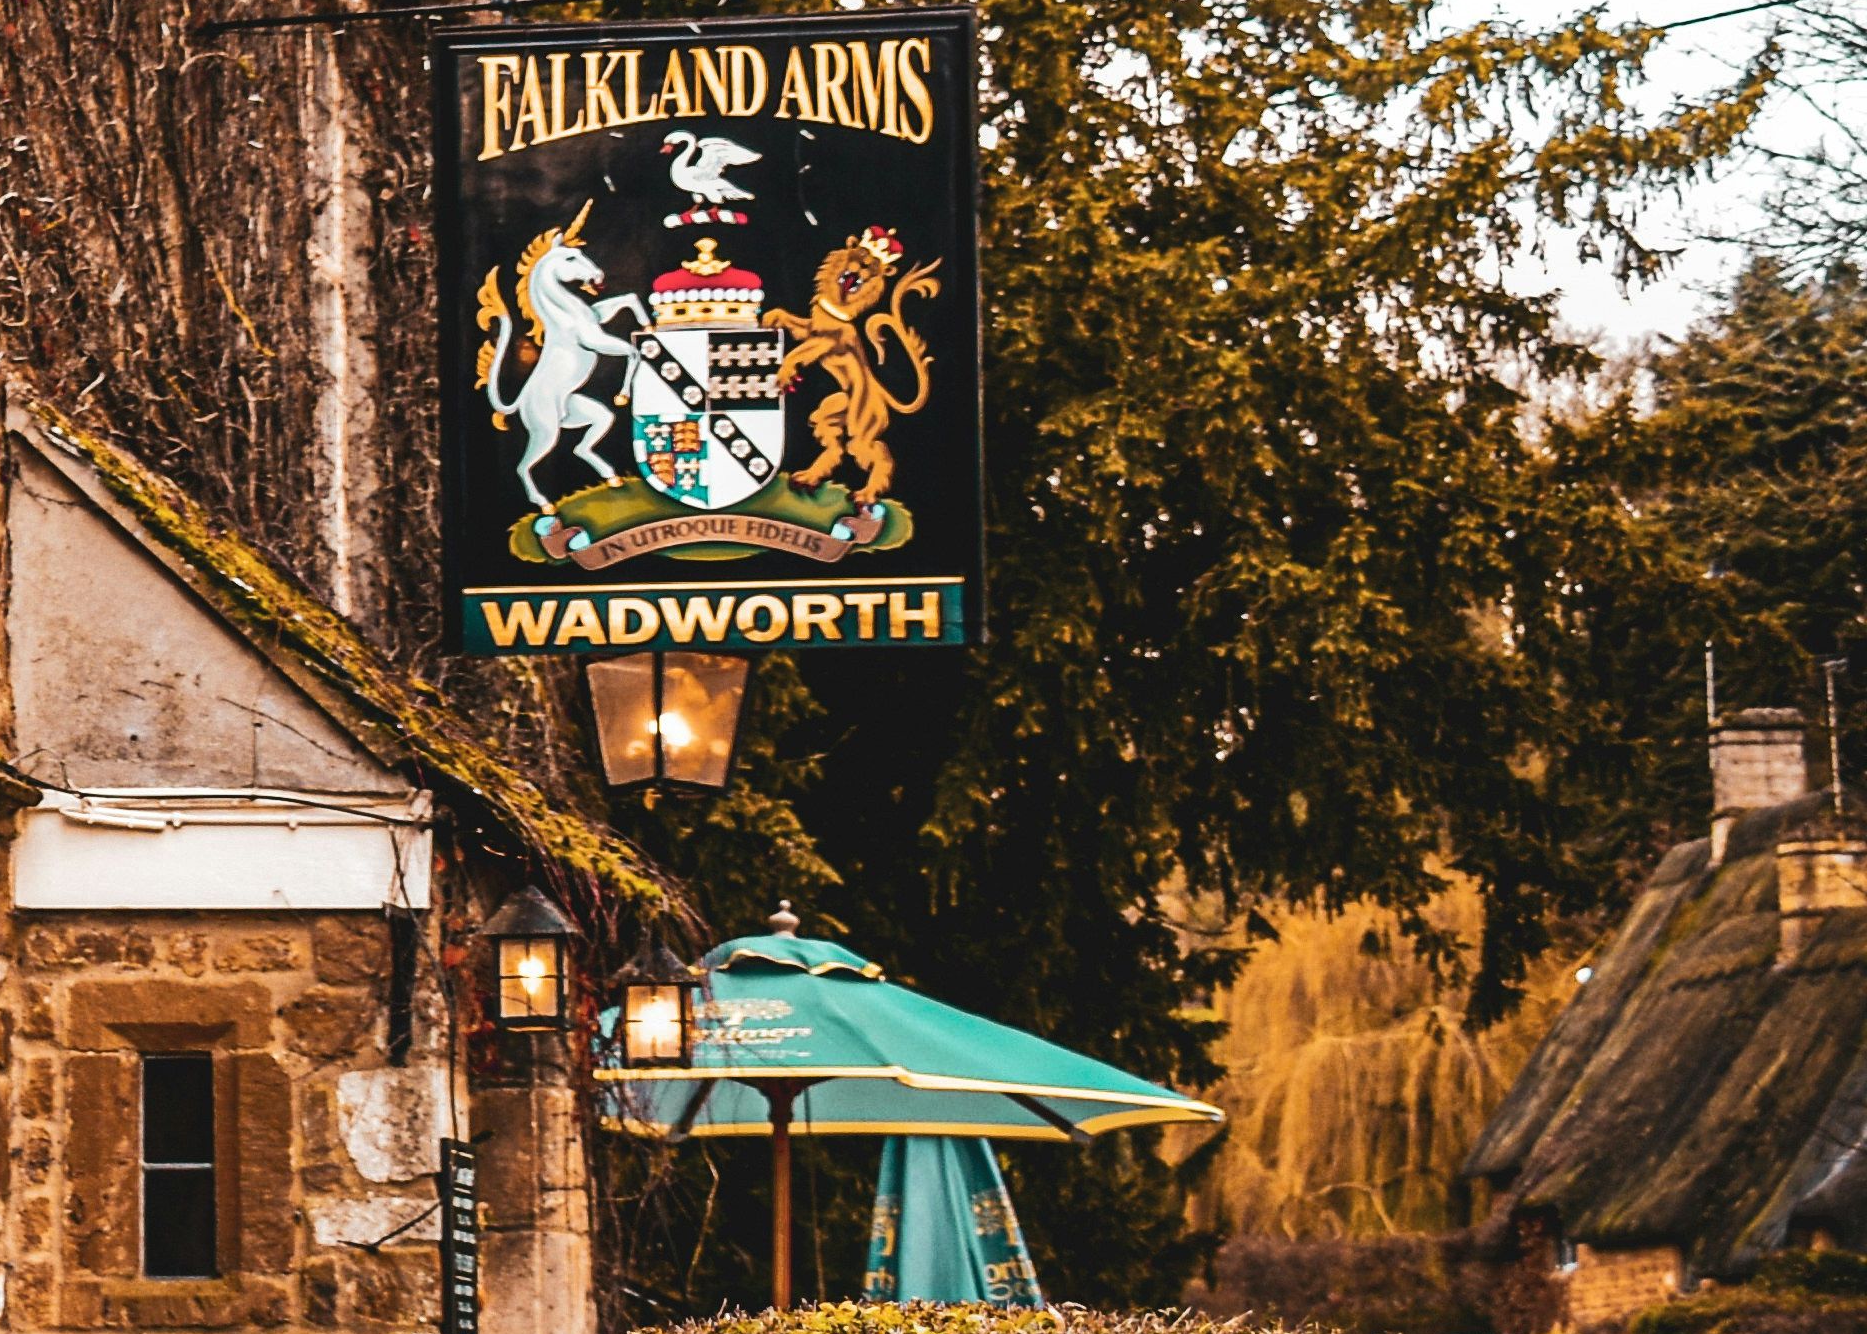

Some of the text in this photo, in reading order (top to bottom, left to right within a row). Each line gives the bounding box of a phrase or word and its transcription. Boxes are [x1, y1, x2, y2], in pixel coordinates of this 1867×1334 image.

[476, 37, 934, 162] FALKLAND ARMS
[598, 518, 823, 561] IN UTROQUE FIDELIS
[480, 591, 941, 647] WADWORTH
